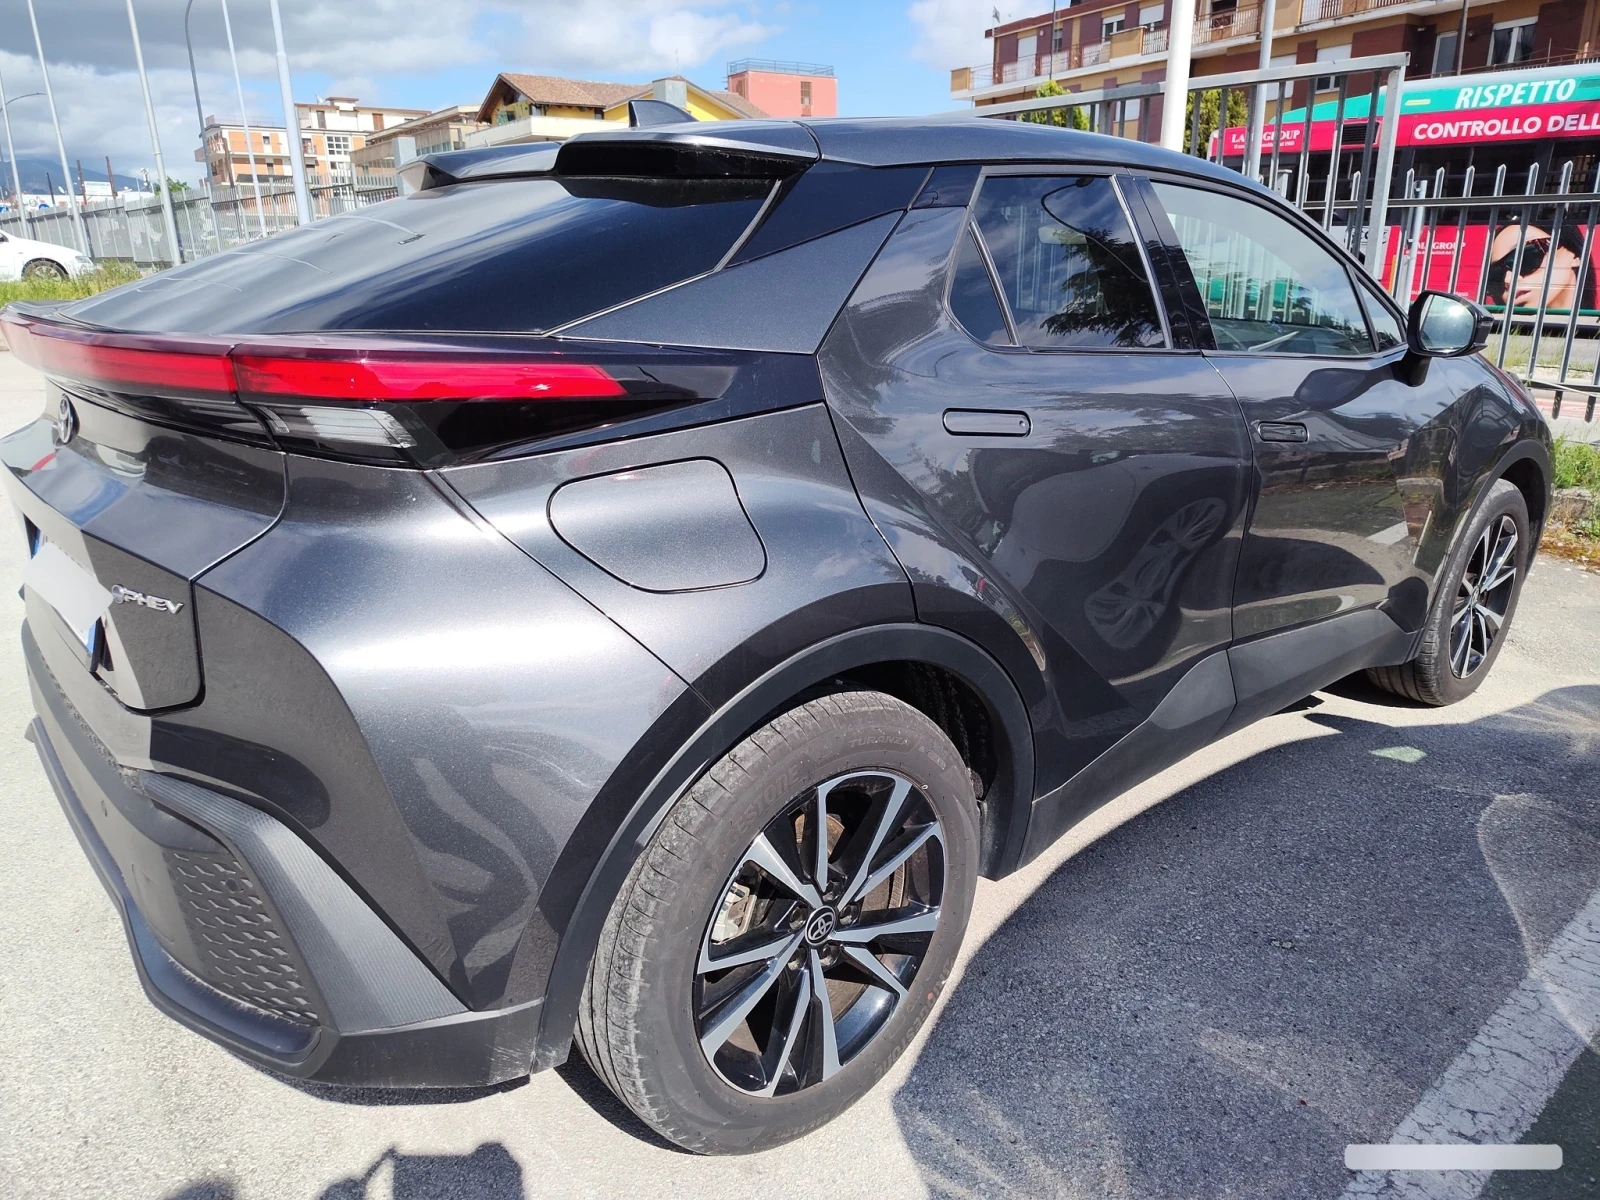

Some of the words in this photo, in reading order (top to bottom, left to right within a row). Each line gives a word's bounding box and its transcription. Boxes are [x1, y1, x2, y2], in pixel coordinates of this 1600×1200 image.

[1455, 79, 1576, 109] RISPETTO
[1414, 116, 1541, 140] CONTROLLO
[123, 588, 184, 614] PHEV
[848, 735, 910, 748] TURANZA
